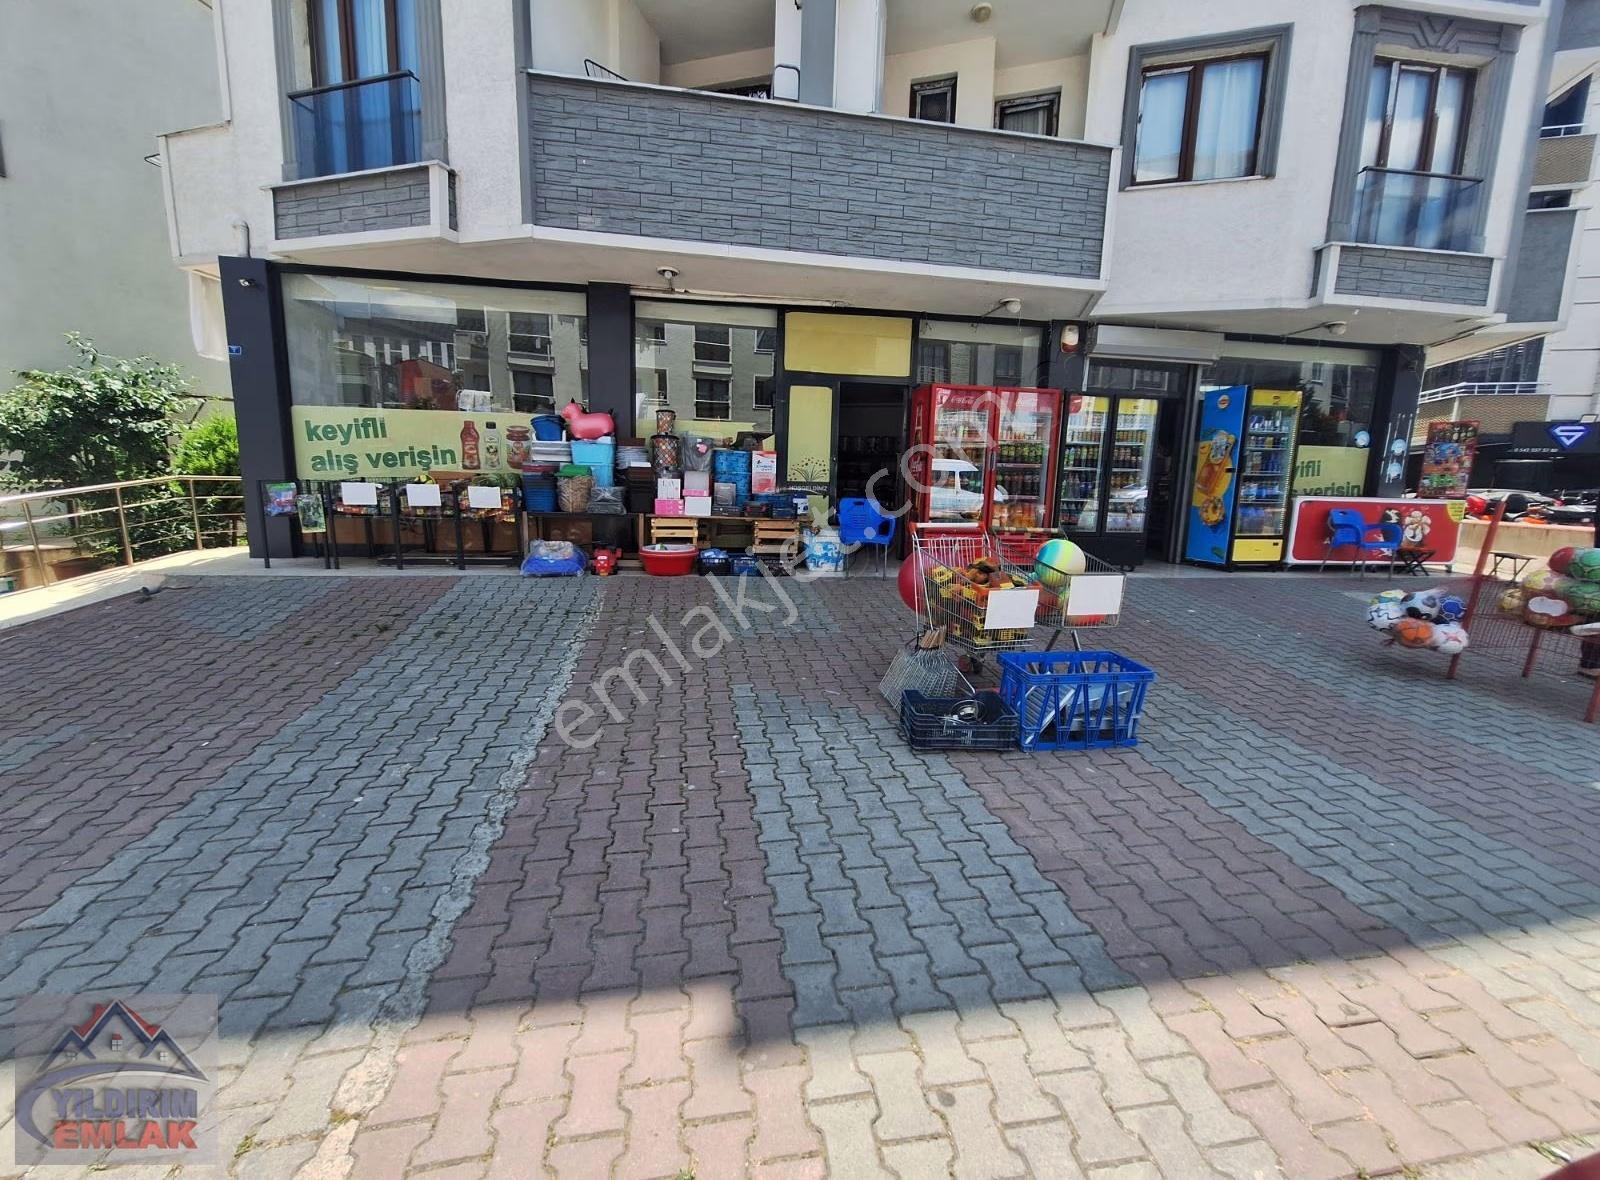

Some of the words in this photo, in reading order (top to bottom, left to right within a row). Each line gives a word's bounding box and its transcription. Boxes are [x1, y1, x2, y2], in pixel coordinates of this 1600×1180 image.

[304, 417, 387, 445] keyifli
[311, 450, 359, 475] alış
[365, 445, 457, 470] verişin
